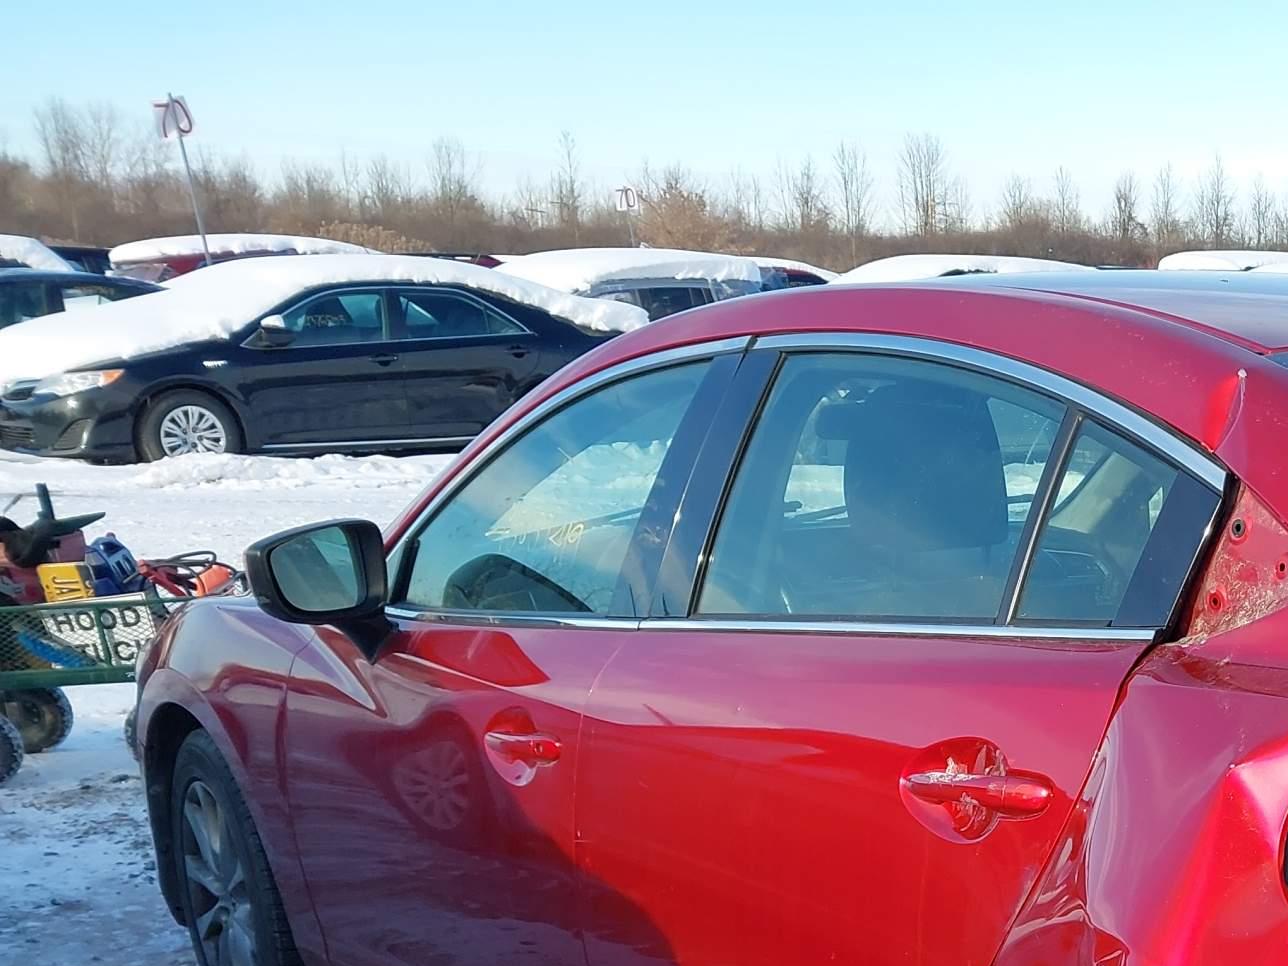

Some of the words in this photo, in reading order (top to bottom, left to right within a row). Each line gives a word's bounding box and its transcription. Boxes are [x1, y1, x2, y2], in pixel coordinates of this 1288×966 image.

[153, 100, 192, 138] 70
[615, 187, 636, 209] 70
[52, 606, 141, 633] HOOD
